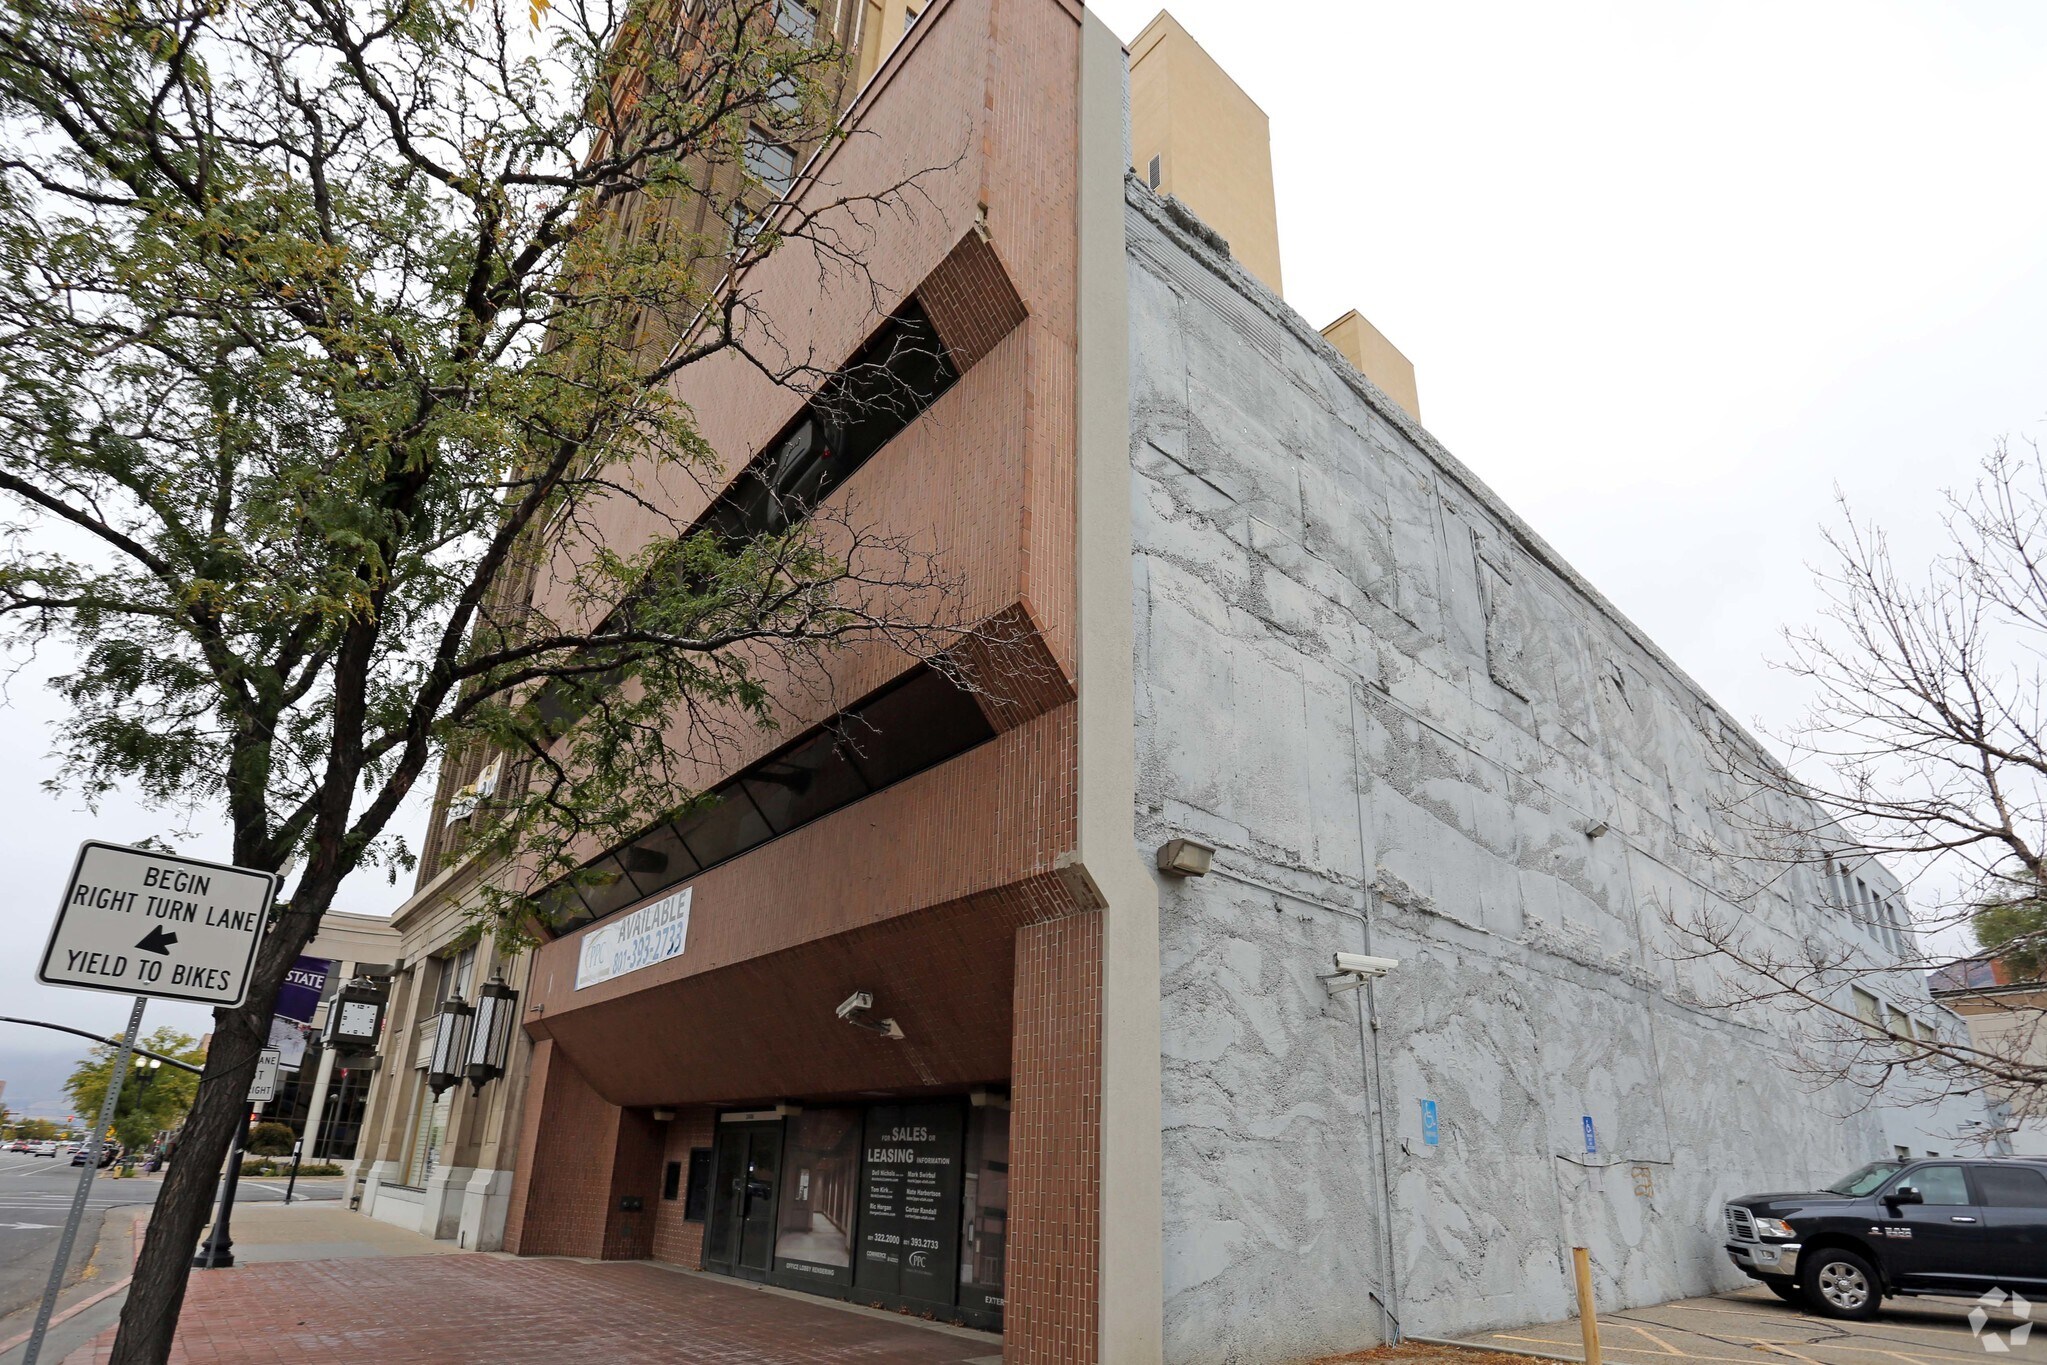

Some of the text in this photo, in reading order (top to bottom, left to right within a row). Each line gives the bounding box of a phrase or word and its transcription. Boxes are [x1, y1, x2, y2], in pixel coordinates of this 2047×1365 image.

[143, 867, 212, 896] BEGIN
[72, 885, 257, 932] RIGHT TURN LANE
[617, 891, 687, 943] AVAILABLE
[612, 921, 684, 975] 801-393-2733
[67, 949, 231, 991] YIELD TO BIKES
[285, 970, 325, 989] STATE
[259, 1057, 277, 1065] ANE
[251, 1086, 271, 1094] IGHT
[892, 1127, 927, 1142] SALES
[867, 1149, 950, 1165] LEASING INFORMATION
[874, 1233, 900, 1244] 322.2000
[910, 1237, 939, 1249] 393.2733
[913, 1255, 926, 1268] PPC
